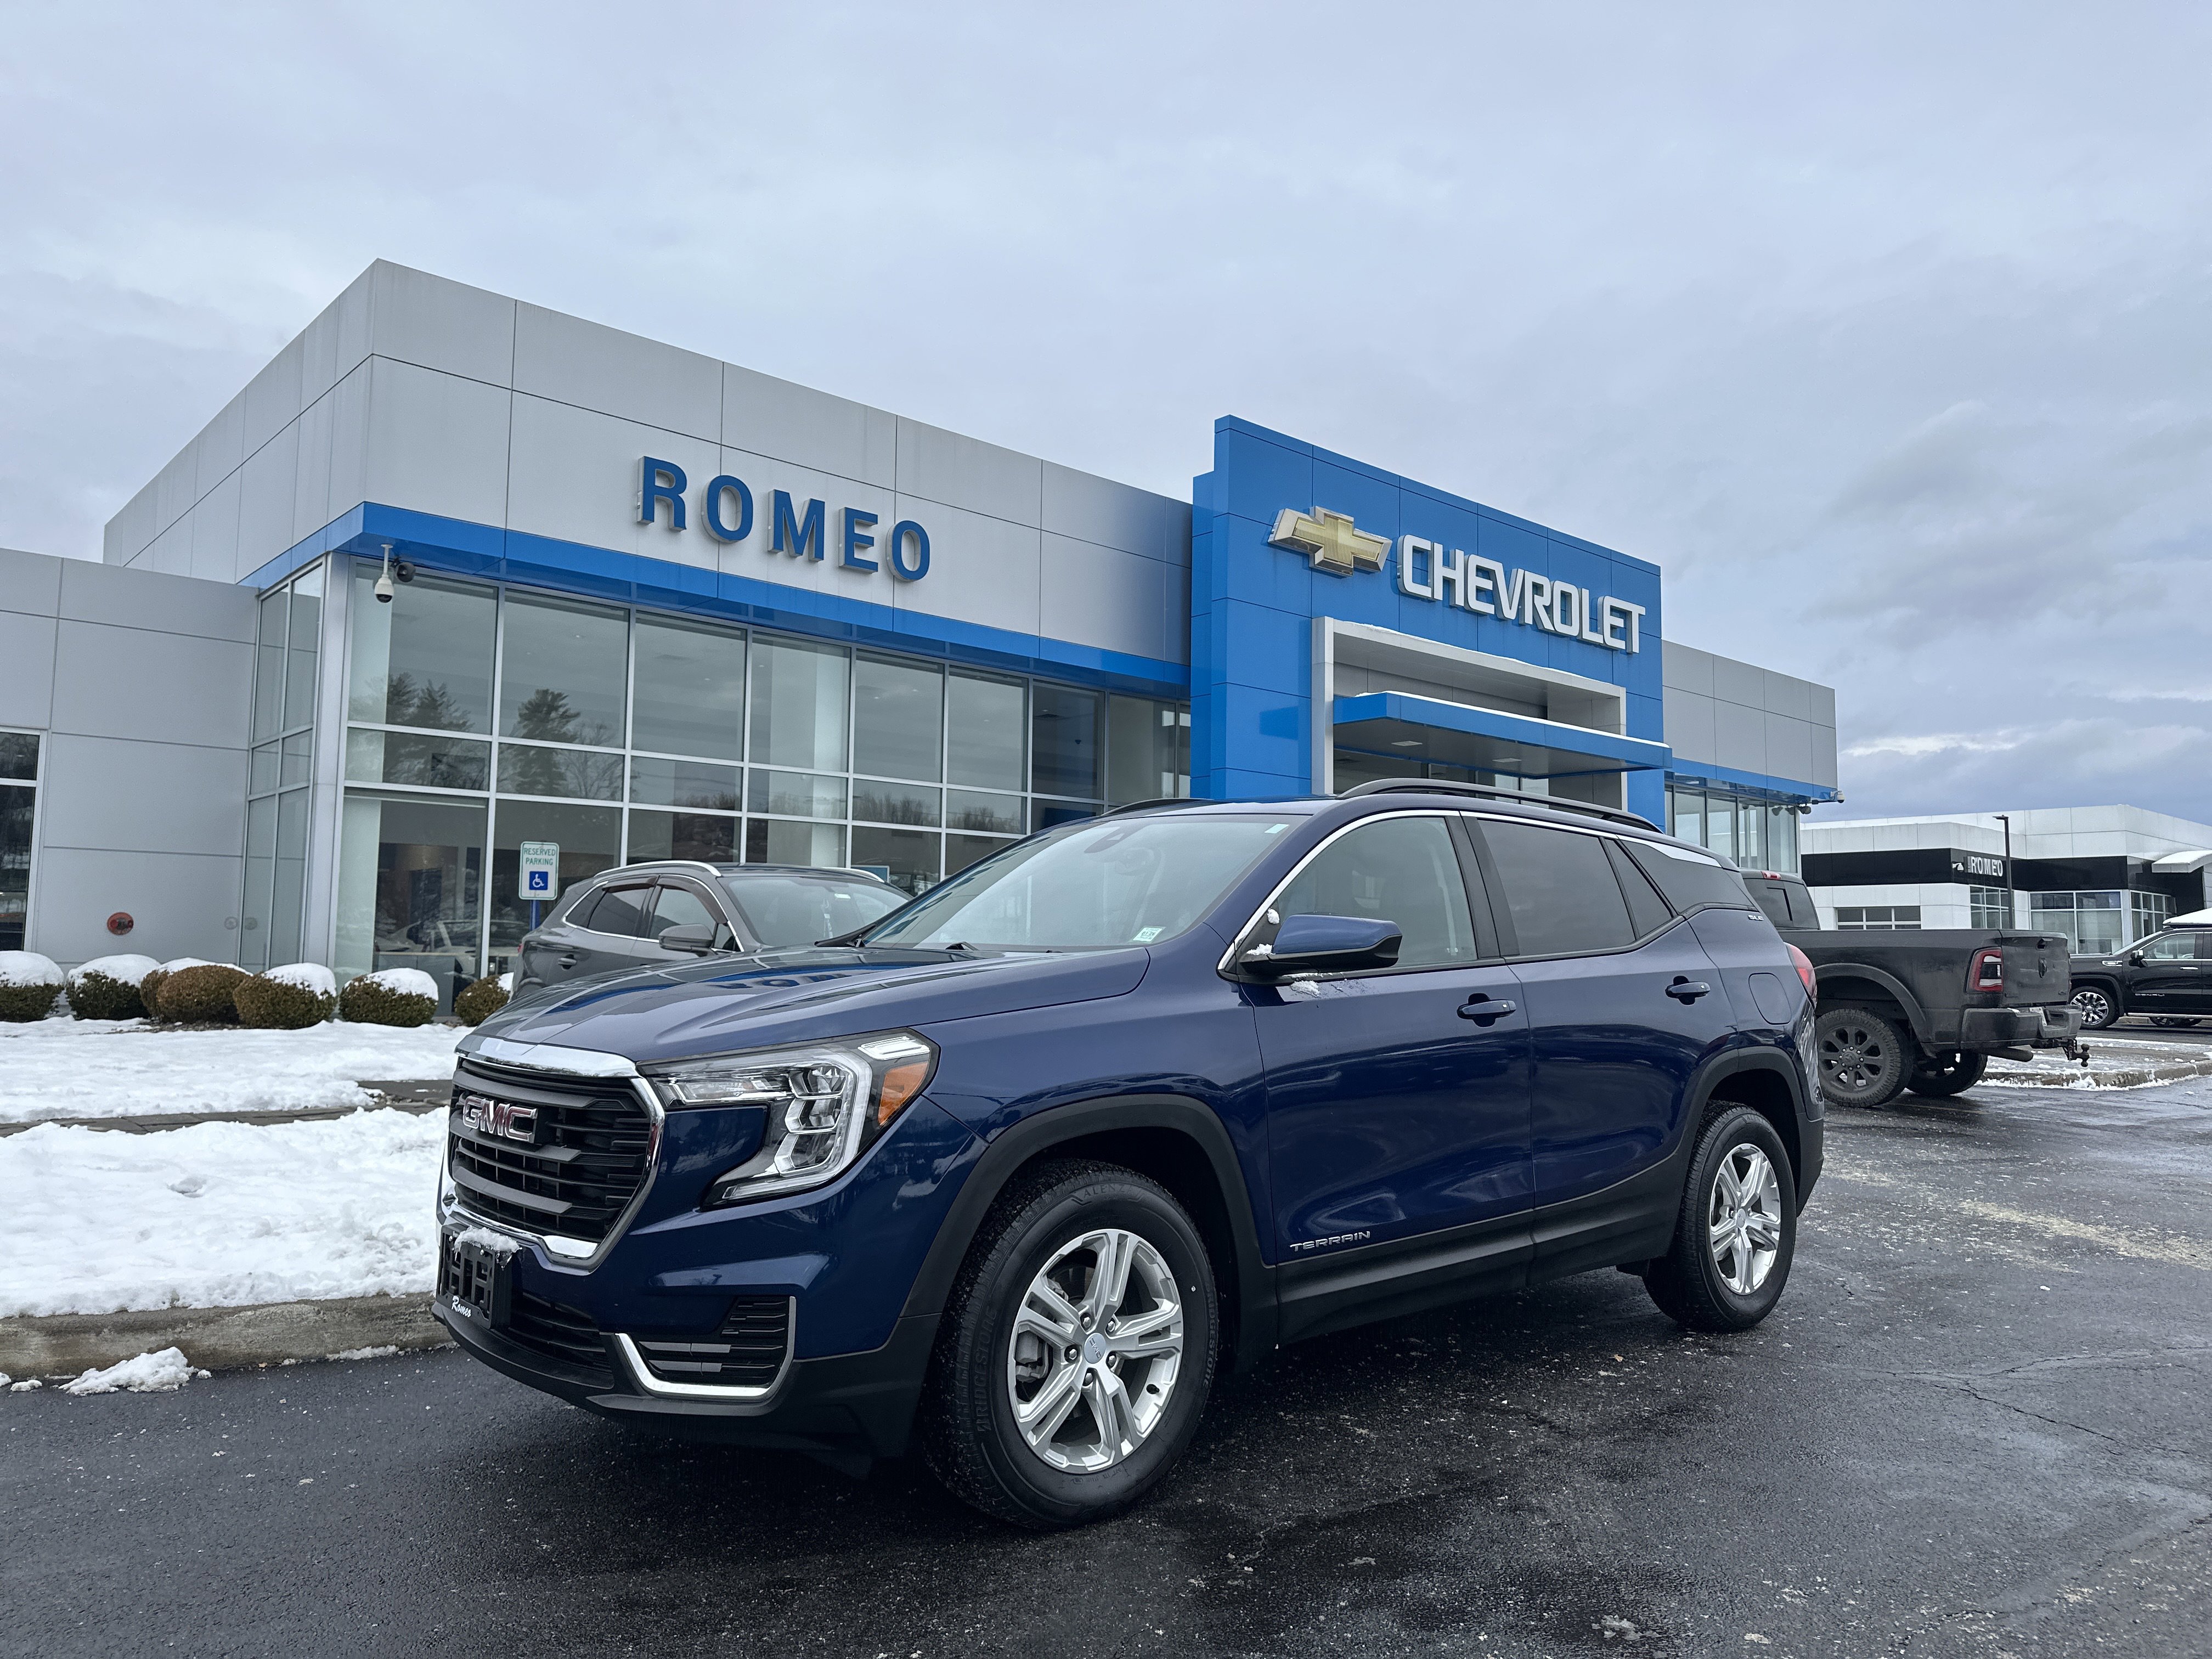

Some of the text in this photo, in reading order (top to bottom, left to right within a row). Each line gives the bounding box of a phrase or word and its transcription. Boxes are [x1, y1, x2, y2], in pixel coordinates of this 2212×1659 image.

[638, 456, 930, 582] ROMEO
[1397, 534, 1646, 654] CHEVROLET
[523, 848, 556, 856] RESERVED
[525, 857, 554, 866] PARKING
[1968, 856, 2003, 877] ROMEO
[463, 1095, 538, 1144] GMC
[1290, 1231, 1370, 1252] TERRAIN
[452, 1295, 471, 1318] Romeo
[1089, 1337, 1102, 1359] GMC
